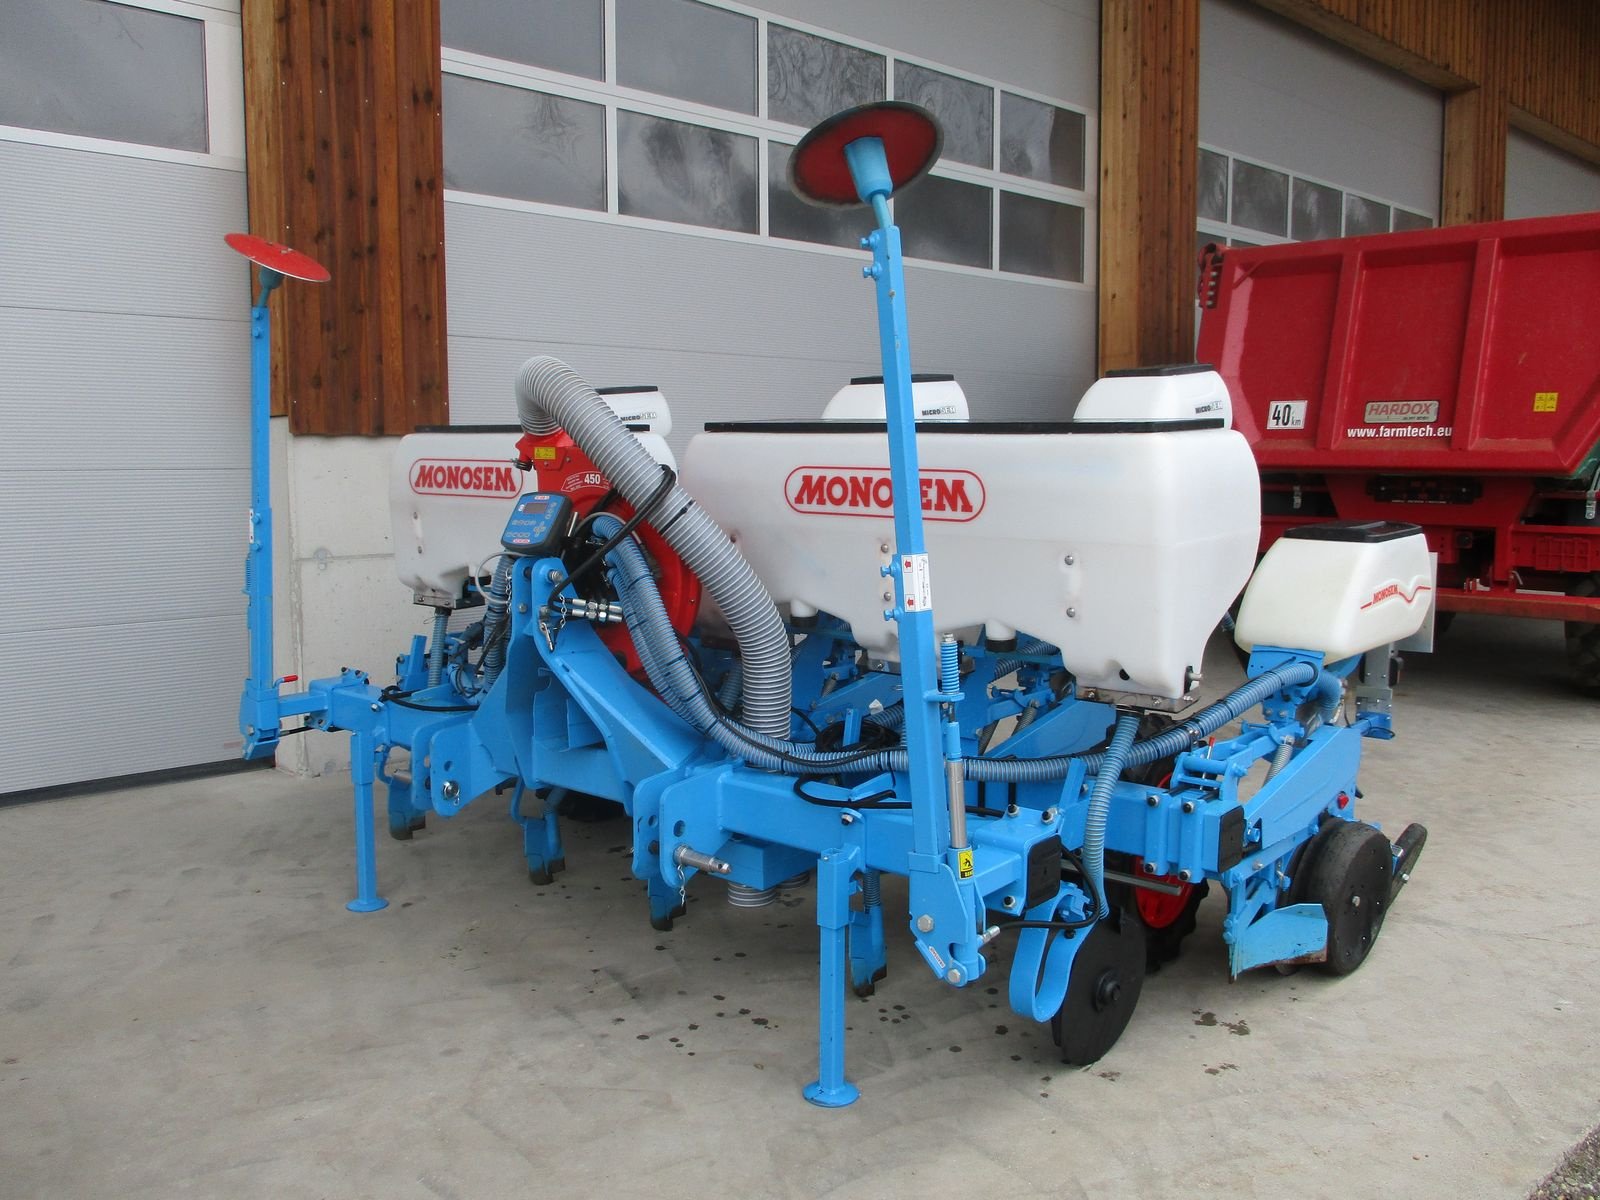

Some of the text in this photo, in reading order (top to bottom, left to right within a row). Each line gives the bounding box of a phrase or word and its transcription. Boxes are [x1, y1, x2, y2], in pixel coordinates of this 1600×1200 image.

[1272, 404, 1302, 426] 40 km
[1368, 402, 1433, 416] HARDOX
[1347, 424, 1453, 438] www.farmtech.eu
[414, 465, 516, 492] MONOSEM
[584, 473, 601, 485] 450
[795, 475, 973, 513] MONOEM
